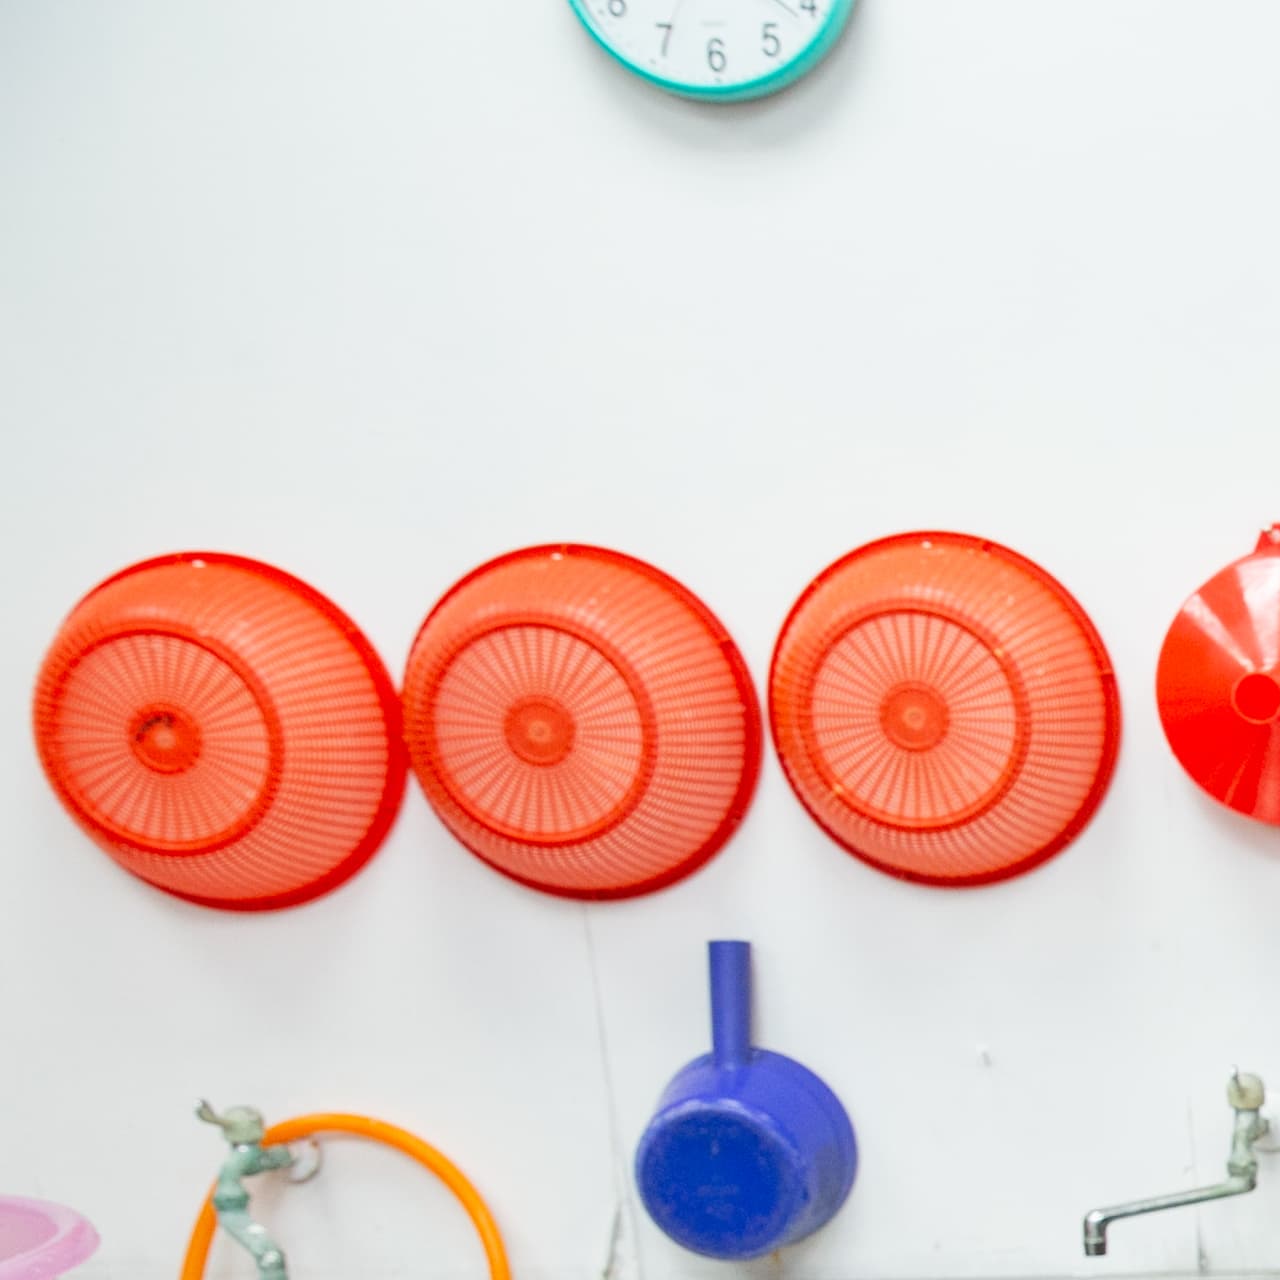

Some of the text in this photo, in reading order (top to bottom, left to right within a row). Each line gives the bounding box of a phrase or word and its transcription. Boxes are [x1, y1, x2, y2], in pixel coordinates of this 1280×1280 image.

[656, 23, 673, 56] 7
[707, 38, 726, 72] 6
[762, 23, 781, 57] 5
